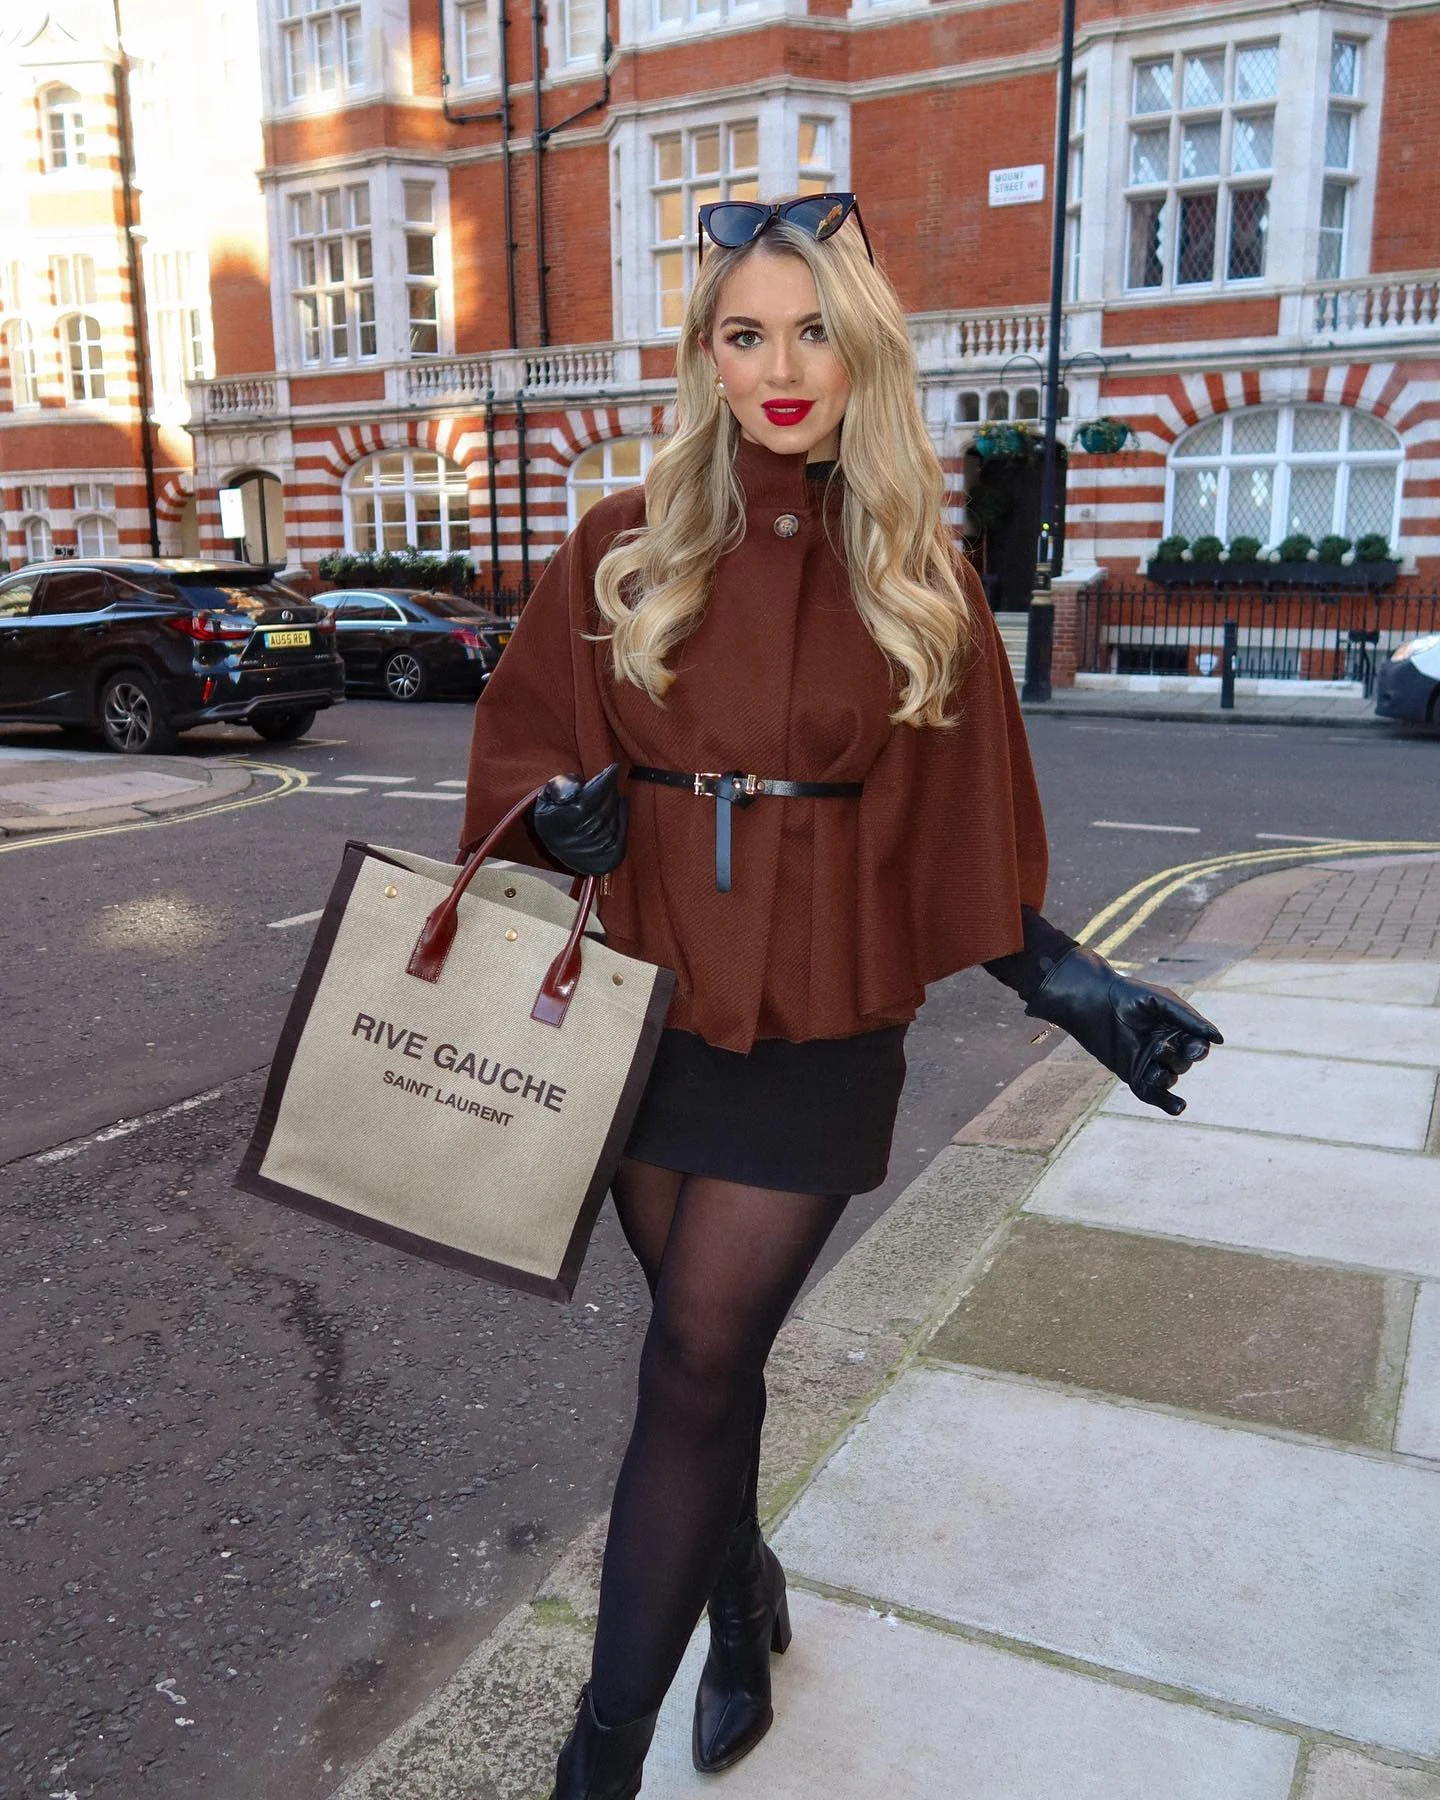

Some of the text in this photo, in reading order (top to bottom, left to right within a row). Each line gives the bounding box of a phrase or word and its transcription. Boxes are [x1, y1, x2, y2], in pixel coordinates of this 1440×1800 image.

[995, 171, 1024, 182] MOUNT
[995, 180, 1038, 193] STREET W1
[352, 1012, 567, 1113] RIVE GAUCHE
[382, 1070, 514, 1127] SAINT LAURENT
